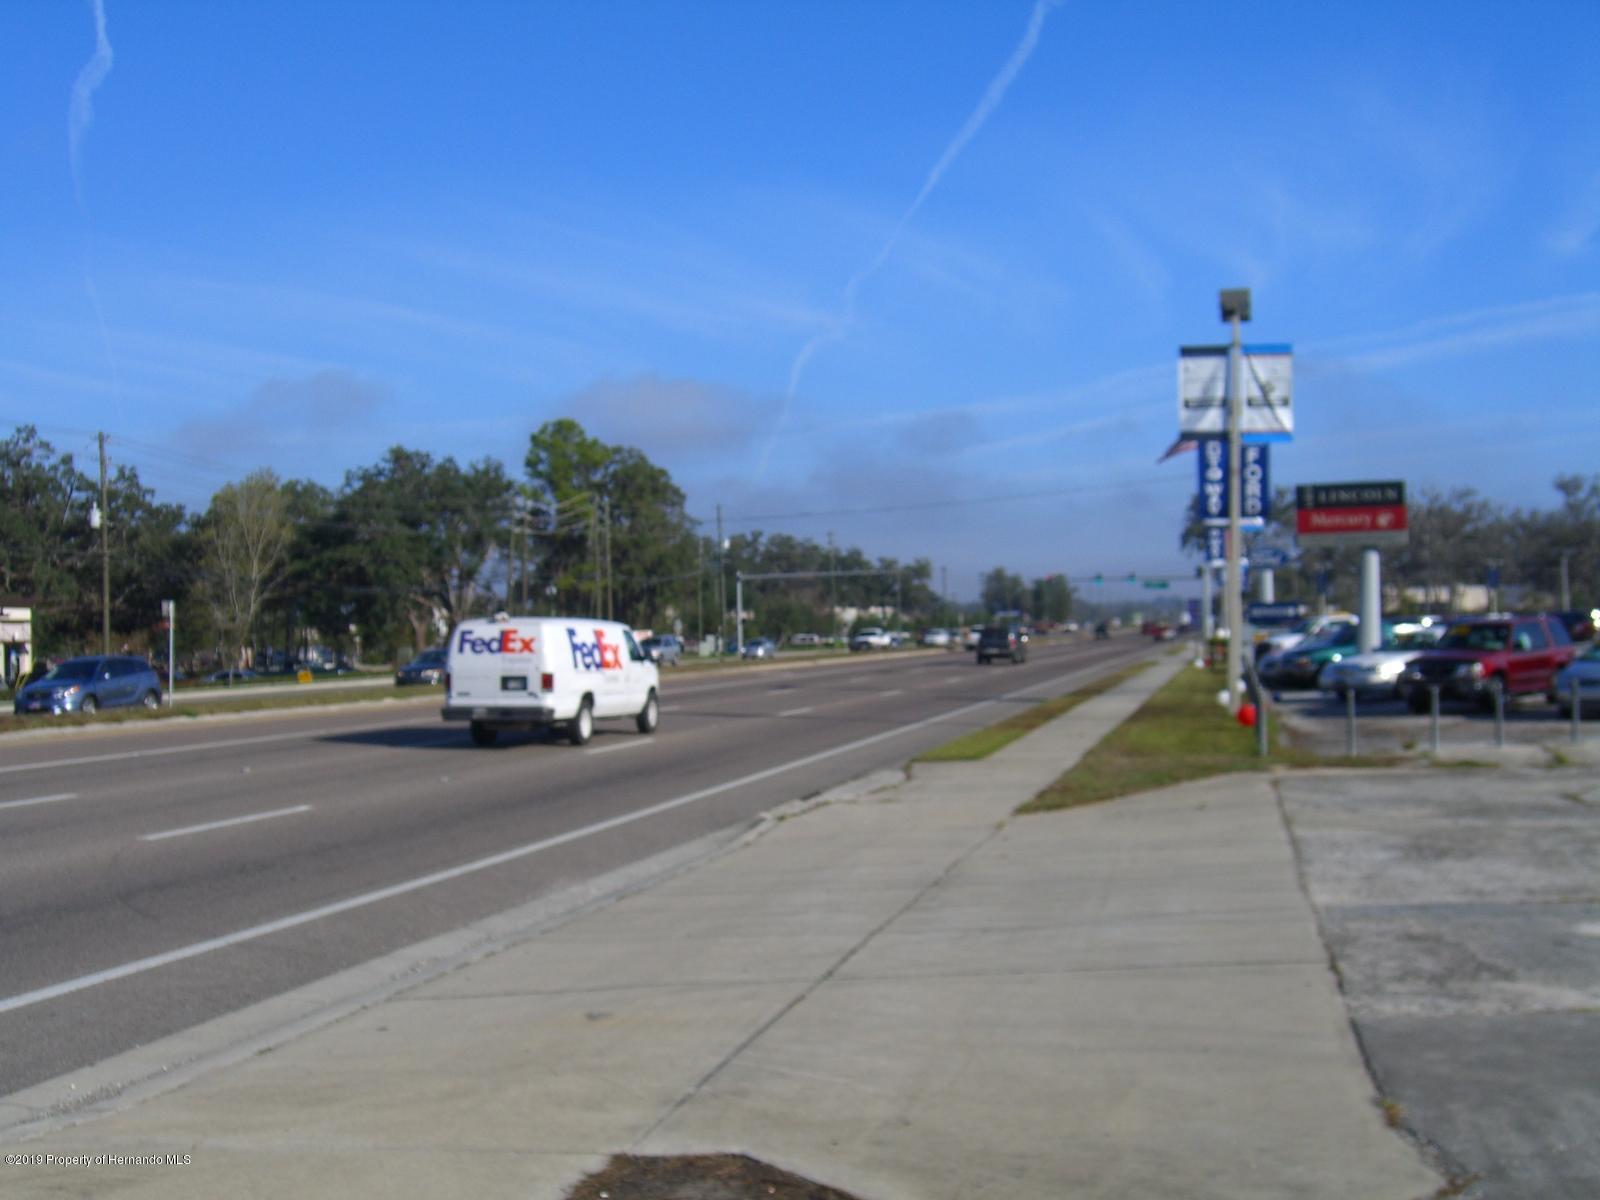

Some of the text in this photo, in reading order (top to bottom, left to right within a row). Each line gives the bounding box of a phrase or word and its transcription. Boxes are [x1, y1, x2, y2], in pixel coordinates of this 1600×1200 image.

[1244, 446, 1263, 515] FORD
[459, 629, 535, 653] FedEx
[566, 628, 623, 669] FedEx
